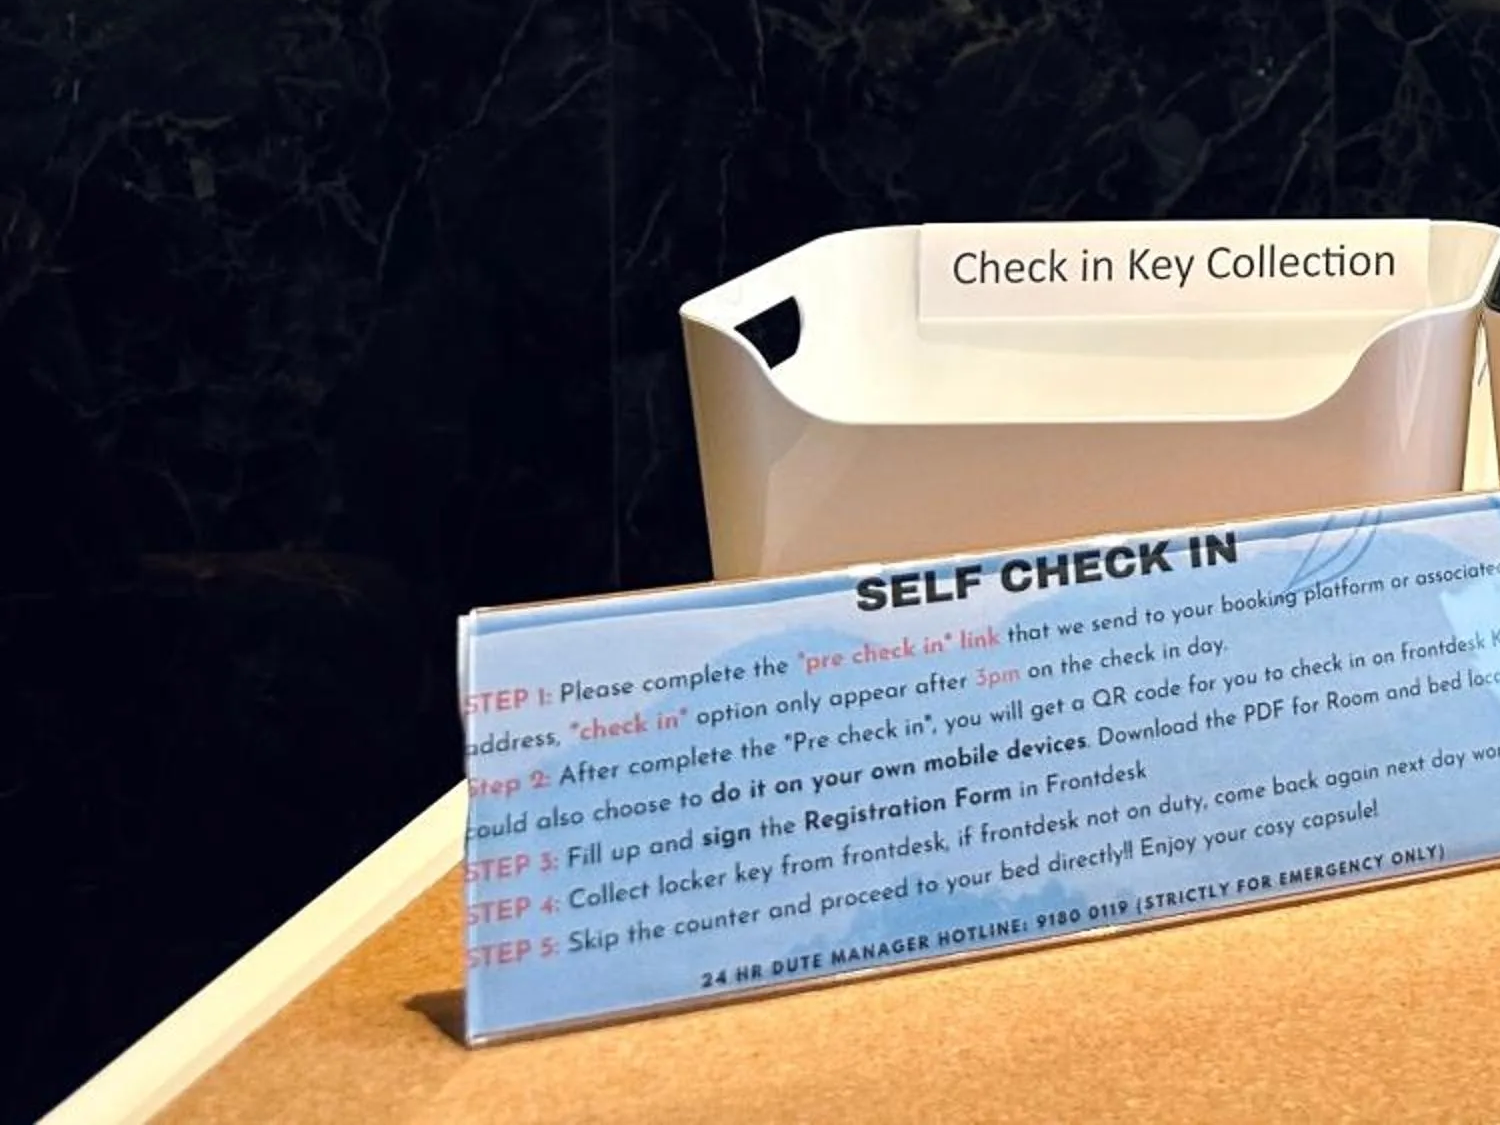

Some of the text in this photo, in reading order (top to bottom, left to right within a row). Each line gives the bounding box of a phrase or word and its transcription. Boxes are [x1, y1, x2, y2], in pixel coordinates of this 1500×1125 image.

[952, 244, 1396, 288] Check in Key Collection
[856, 532, 1237, 612] SELF CHECK IN
[464, 687, 530, 716] STEP
[537, 686, 553, 707] 1:
[559, 678, 635, 705] Please
[640, 662, 747, 694] complete
[753, 654, 789, 679] the
[851, 636, 916, 665] check
[959, 625, 1001, 651] link
[1007, 621, 1051, 644] that
[1056, 620, 1087, 637] we
[1090, 605, 1139, 633] send
[1144, 608, 1166, 626] to
[1170, 602, 1215, 627] your
[1220, 582, 1298, 615] booking
[1301, 576, 1385, 607] platform
[1389, 575, 1411, 591] or
[464, 729, 561, 760] address,
[695, 702, 768, 729] option
[775, 688, 823, 715] only
[828, 683, 909, 711] appear
[914, 671, 969, 696] after
[975, 667, 1021, 690] 3pm
[1027, 663, 1054, 679] on
[1059, 652, 1094, 676] the
[1098, 641, 1156, 669] check
[1162, 642, 1182, 661] in
[1186, 634, 1229, 658] day.
[467, 776, 522, 800] Step
[529, 769, 551, 790] 2:
[558, 759, 621, 787] After
[627, 744, 734, 777] complete
[739, 736, 778, 761] the
[835, 717, 899, 747] check
[943, 713, 983, 734] you
[988, 698, 1024, 724] will
[1029, 698, 1067, 722] get
[1070, 698, 1086, 714] a
[1092, 684, 1129, 709] QR
[1133, 676, 1184, 703] code
[1187, 672, 1217, 695] for
[1221, 672, 1258, 694] you
[1263, 666, 1287, 683] to
[1289, 651, 1344, 680] check
[1348, 652, 1367, 670] in
[1370, 650, 1396, 667] on
[1401, 631, 1486, 663] frontdesk
[466, 896, 532, 926] STEP
[539, 895, 560, 915] 4:
[566, 879, 651, 911] Collect
[657, 867, 728, 897] locker
[734, 860, 774, 885] key
[779, 852, 834, 877] from
[841, 829, 951, 867] frontdesk,
[957, 823, 975, 849] if
[979, 808, 1081, 844] frontdesk
[1085, 804, 1121, 828] not
[1125, 804, 1152, 821] on
[1157, 793, 1209, 816] duty,
[1213, 781, 1267, 807] come
[1271, 769, 1320, 797] back
[1324, 764, 1380, 790] again
[1385, 754, 1426, 778] next
[1430, 748, 1467, 770] day
[466, 797, 1380, 969] STEP 5: Skip the counter and proceed to your bed directly!! Enjoy your cosy capsule!
[699, 842, 1448, 991] 24 HR DUTE MANAGER HOTLINE: 9180 0119 (STRICTLY FOR EMERGENCY ONLY)
